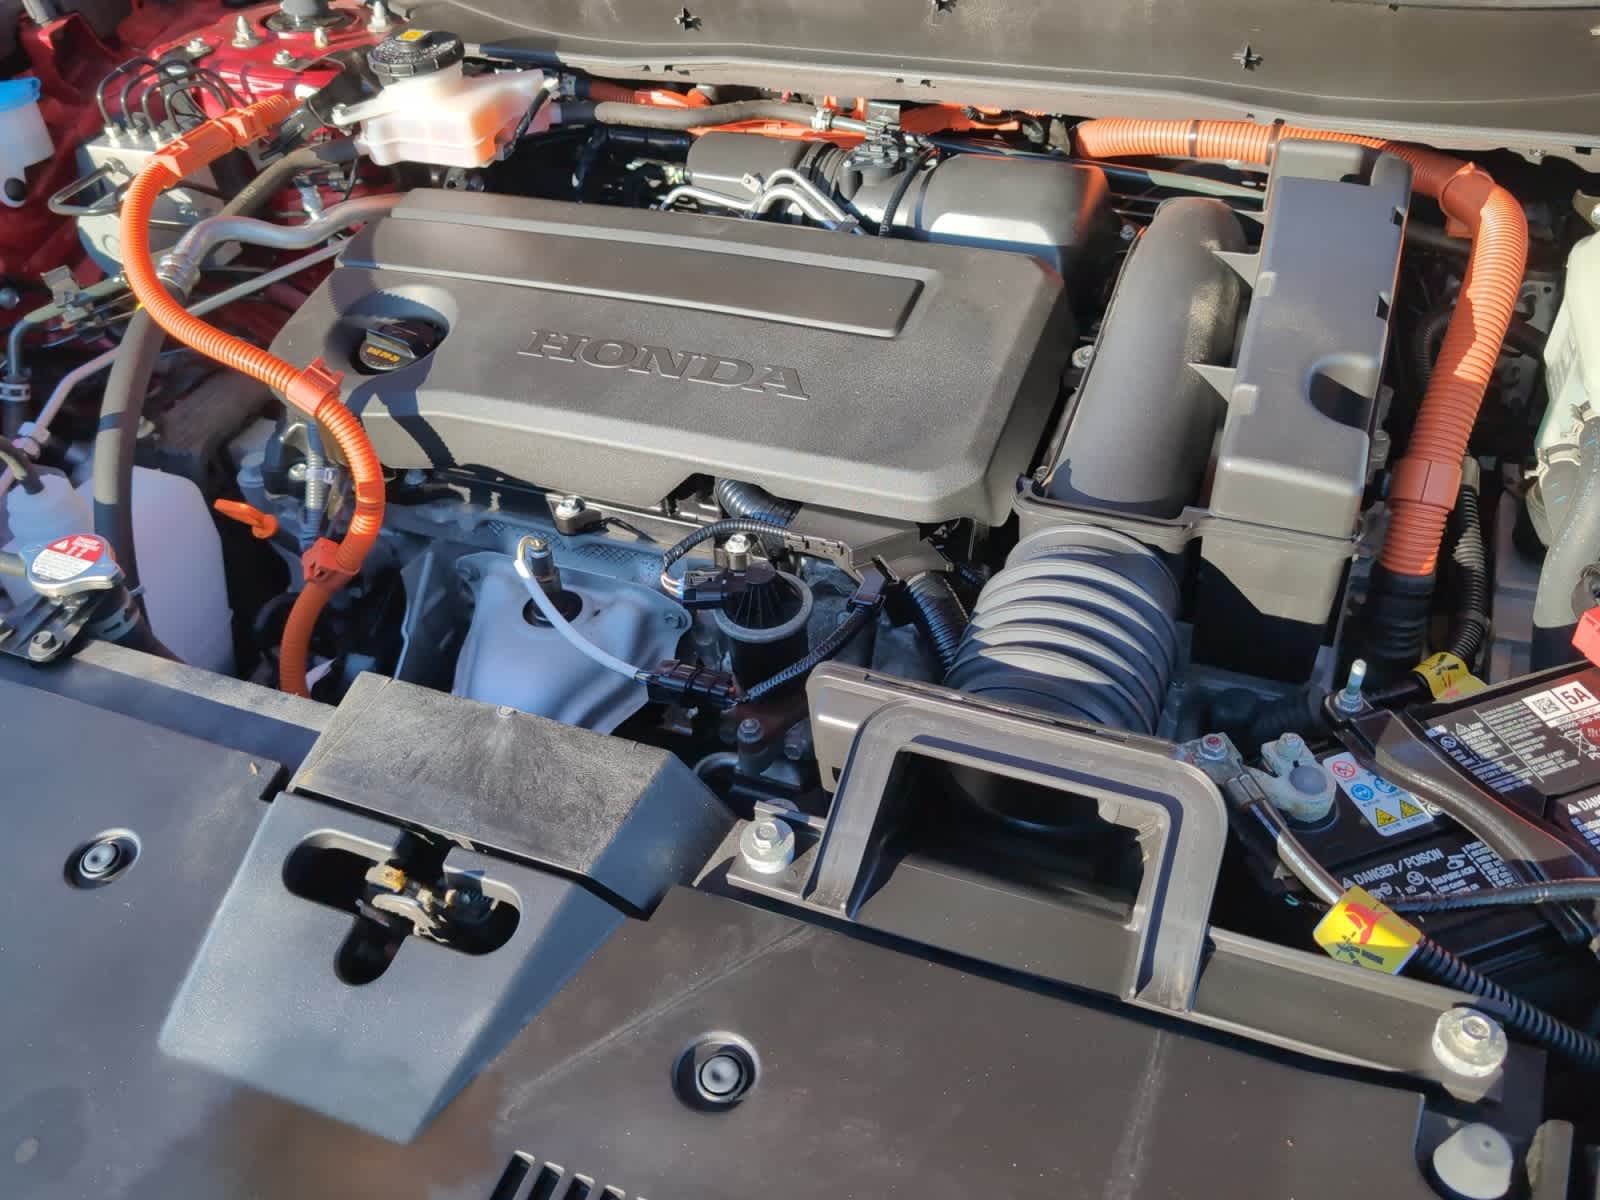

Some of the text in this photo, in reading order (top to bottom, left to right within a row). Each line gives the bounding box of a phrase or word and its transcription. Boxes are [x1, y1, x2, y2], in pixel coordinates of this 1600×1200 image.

[517, 329, 810, 401] HONDA
[1560, 687, 1591, 705] 5A
[1353, 863, 1398, 885] DANGER
[1403, 847, 1444, 868] POISON
